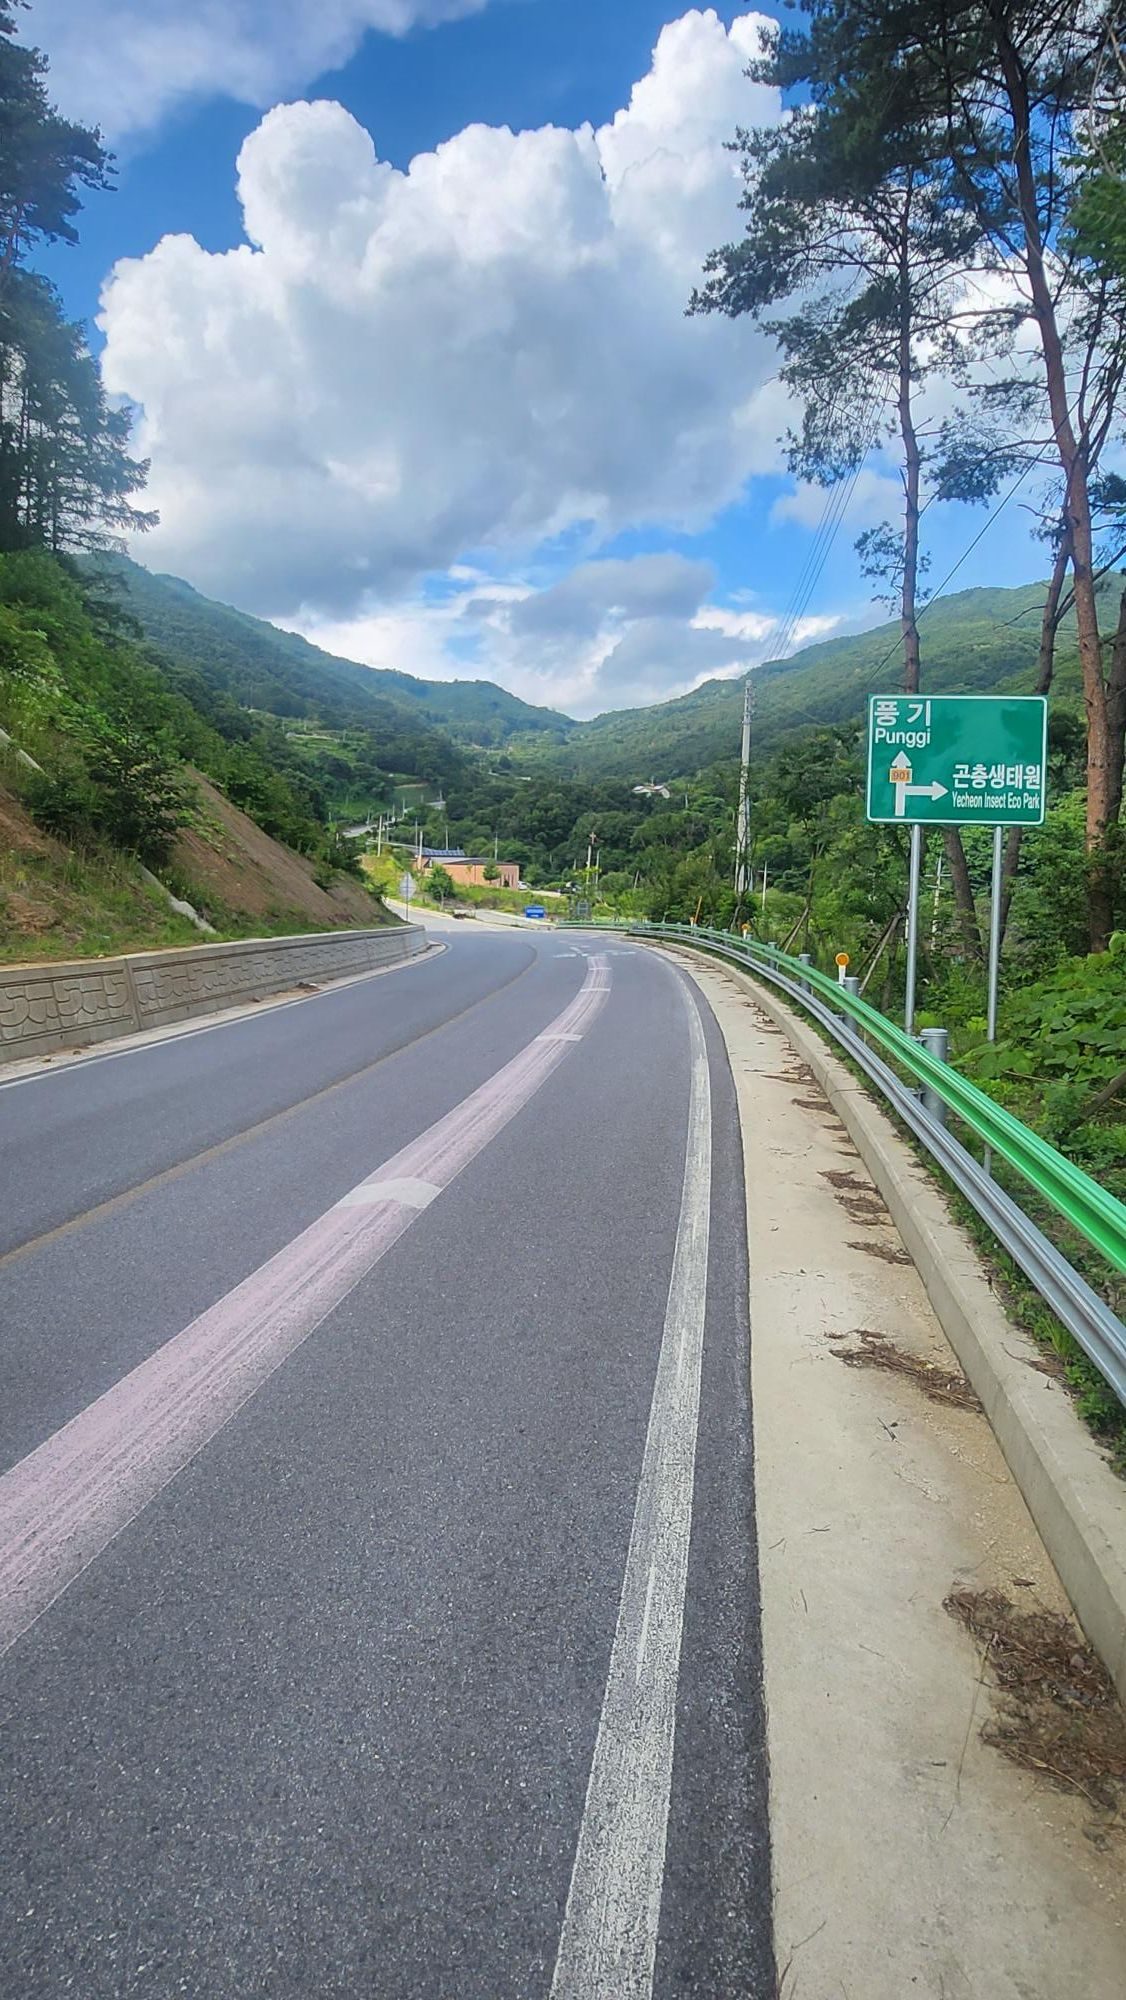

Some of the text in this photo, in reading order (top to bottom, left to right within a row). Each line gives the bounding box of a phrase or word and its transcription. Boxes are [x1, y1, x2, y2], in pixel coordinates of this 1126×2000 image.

[874, 728, 931, 748] Punggi
[893, 771, 910, 780] 901
[952, 764, 1041, 789] 곤충생태원
[952, 791, 1040, 809] Yecheon Insect Eco Park
